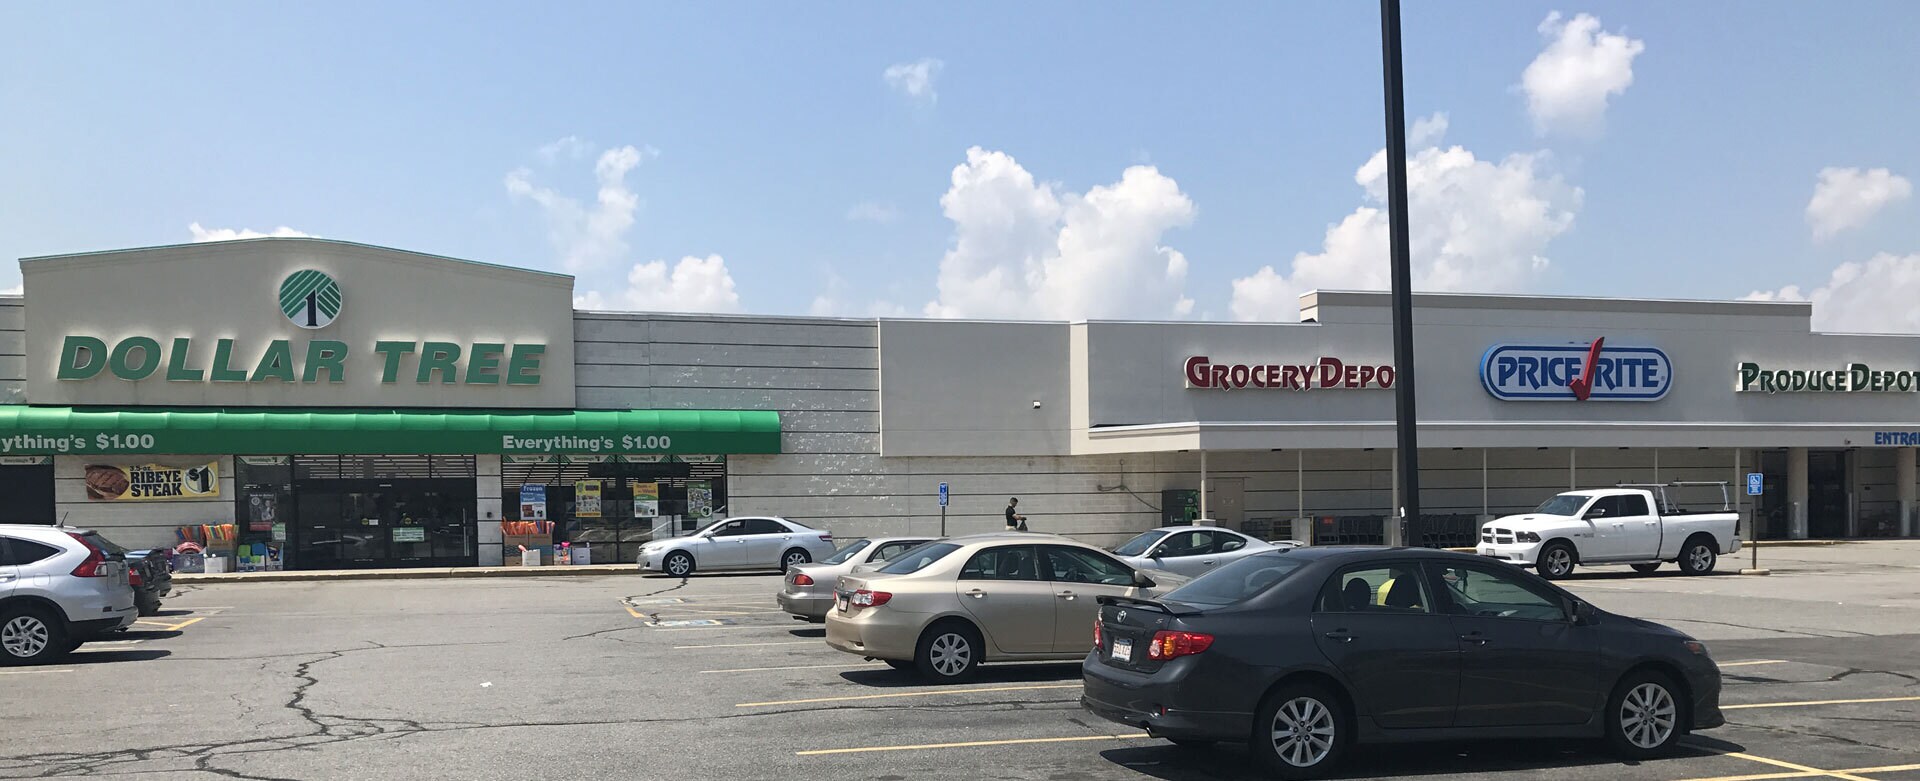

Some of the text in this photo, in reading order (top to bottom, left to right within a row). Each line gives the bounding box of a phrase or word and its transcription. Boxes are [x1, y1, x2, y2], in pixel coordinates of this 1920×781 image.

[57, 335, 546, 385] DOLLAR TREE
[1186, 356, 1394, 391] GROCERY DEPO
[1498, 356, 1659, 391] PRICE RITE
[1740, 362, 1847, 394] PRODUCE
[1, 432, 155, 452] ything's $1.00
[502, 434, 671, 452] Everything's $1.00
[1874, 431, 1920, 446] ENTRA
[130, 470, 182, 484] RIBEYE
[188, 465, 211, 493] $1
[131, 482, 183, 497] STEAK
